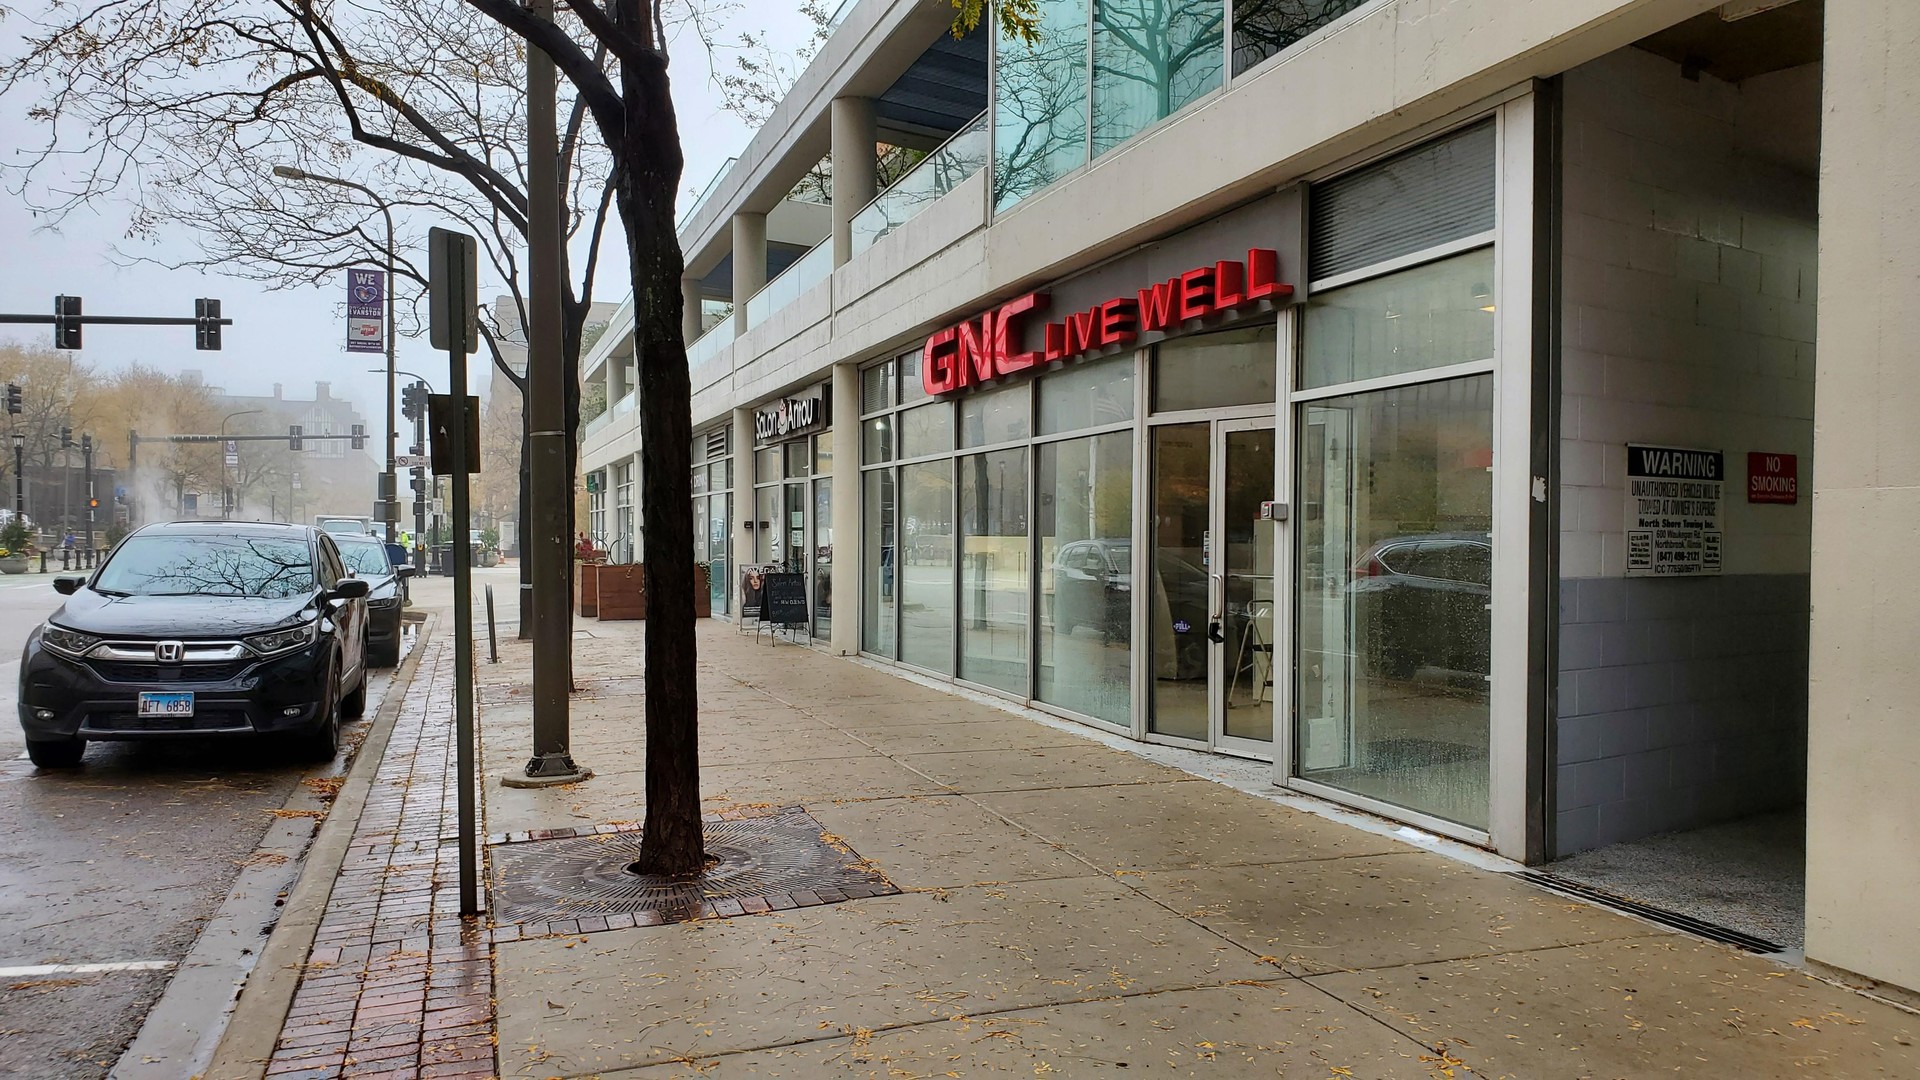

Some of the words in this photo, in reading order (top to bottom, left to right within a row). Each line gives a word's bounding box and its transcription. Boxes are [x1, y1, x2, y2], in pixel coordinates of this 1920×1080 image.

[354, 272, 375, 285] WE
[922, 292, 1051, 396] GNC
[1044, 297, 1137, 361] LIVE
[1137, 247, 1294, 332] WELL
[1642, 450, 1715, 478] WARNING
[1766, 456, 1781, 473] NO
[1631, 480, 1679, 497] UNAUTHORIZED
[1680, 483, 1702, 498] VEHICLES
[1714, 485, 1721, 500] BE
[1751, 475, 1796, 493] SMOKING
[1637, 499, 1661, 515] TOWED
[1661, 500, 1670, 515] AT
[1696, 501, 1716, 516] EXPENSE
[1638, 518, 1660, 528] North
[1661, 518, 1681, 528] Shore
[1683, 519, 1703, 530] Towing
[1704, 520, 1715, 529] Inc.
[1656, 530, 1666, 538] 600
[1657, 551, 1673, 562] (847)
[747, 566, 776, 575] AVEDA
[1655, 564, 1666, 574] ICC
[166, 699, 191, 713] 6858
